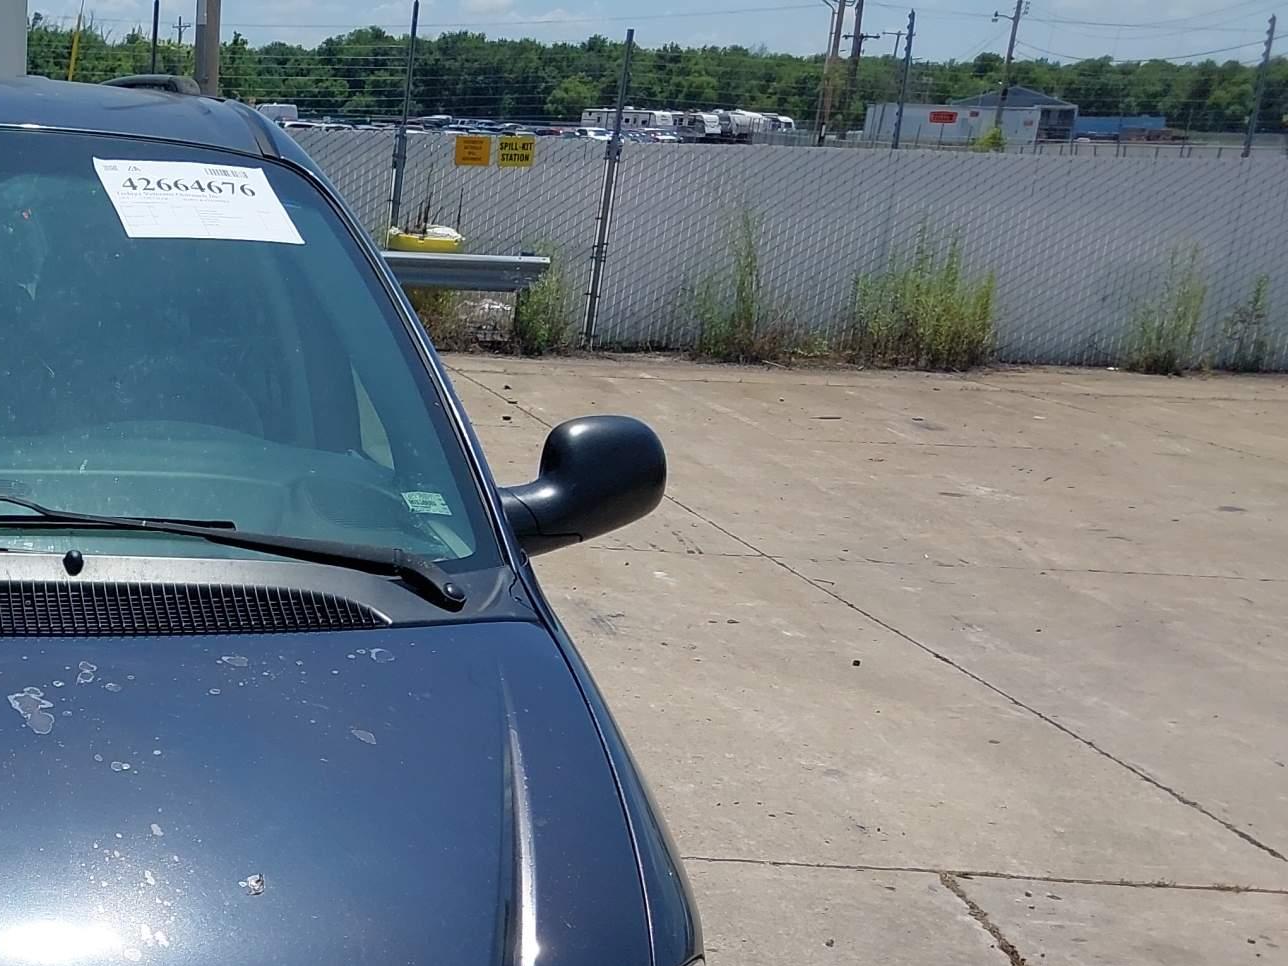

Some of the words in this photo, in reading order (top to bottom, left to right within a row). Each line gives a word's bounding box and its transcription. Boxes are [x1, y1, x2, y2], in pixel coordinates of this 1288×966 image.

[499, 142, 534, 151] SPILL-KIT
[501, 153, 530, 162] STATION
[122, 177, 256, 197] 42664676
